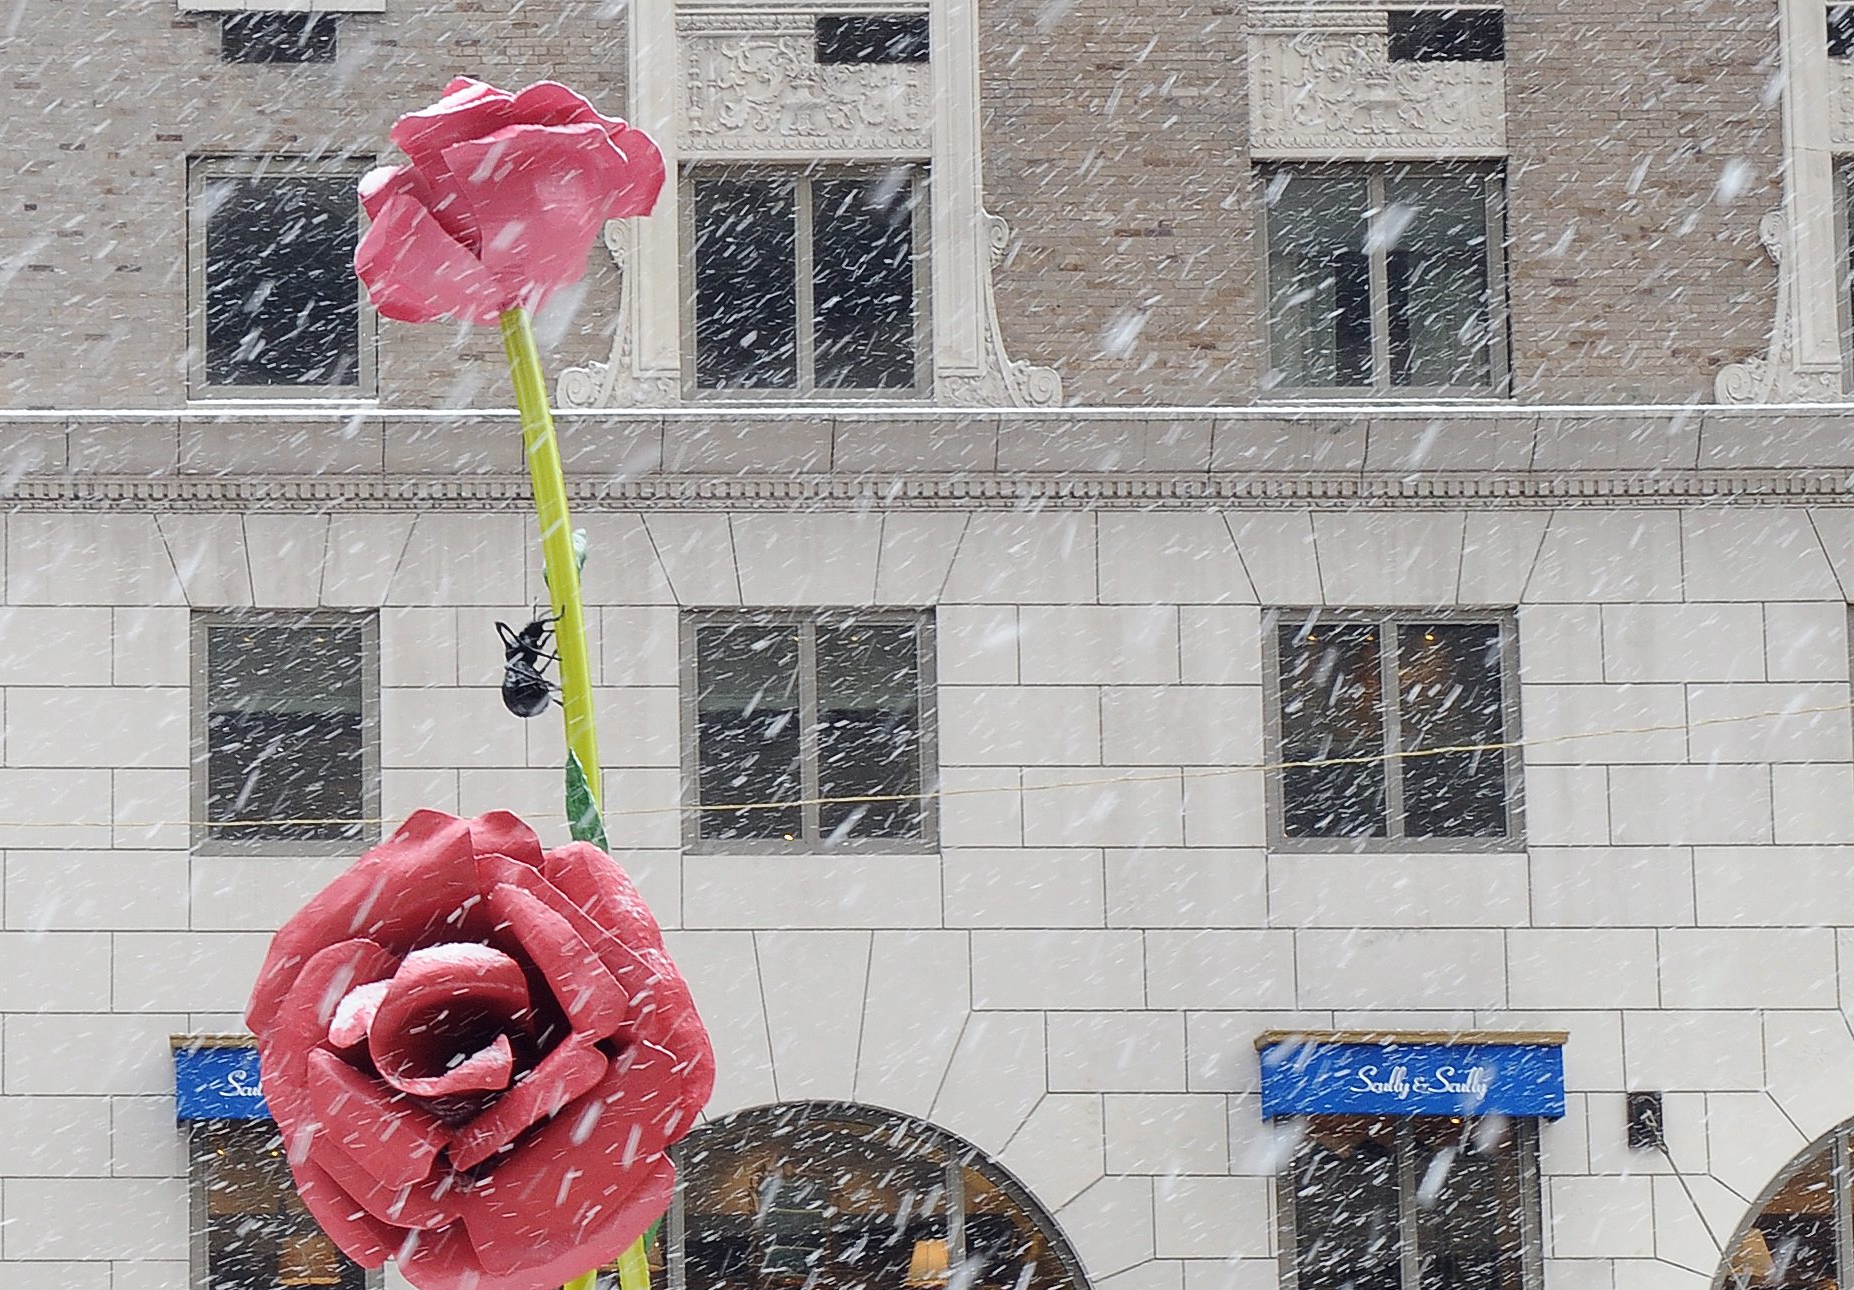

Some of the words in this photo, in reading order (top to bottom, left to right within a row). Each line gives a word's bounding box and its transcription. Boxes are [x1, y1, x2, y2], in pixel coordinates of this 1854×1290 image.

[1350, 1065, 1410, 1099] Scully
[1412, 1076, 1431, 1093] &
[1428, 1065, 1488, 1100] Scully
